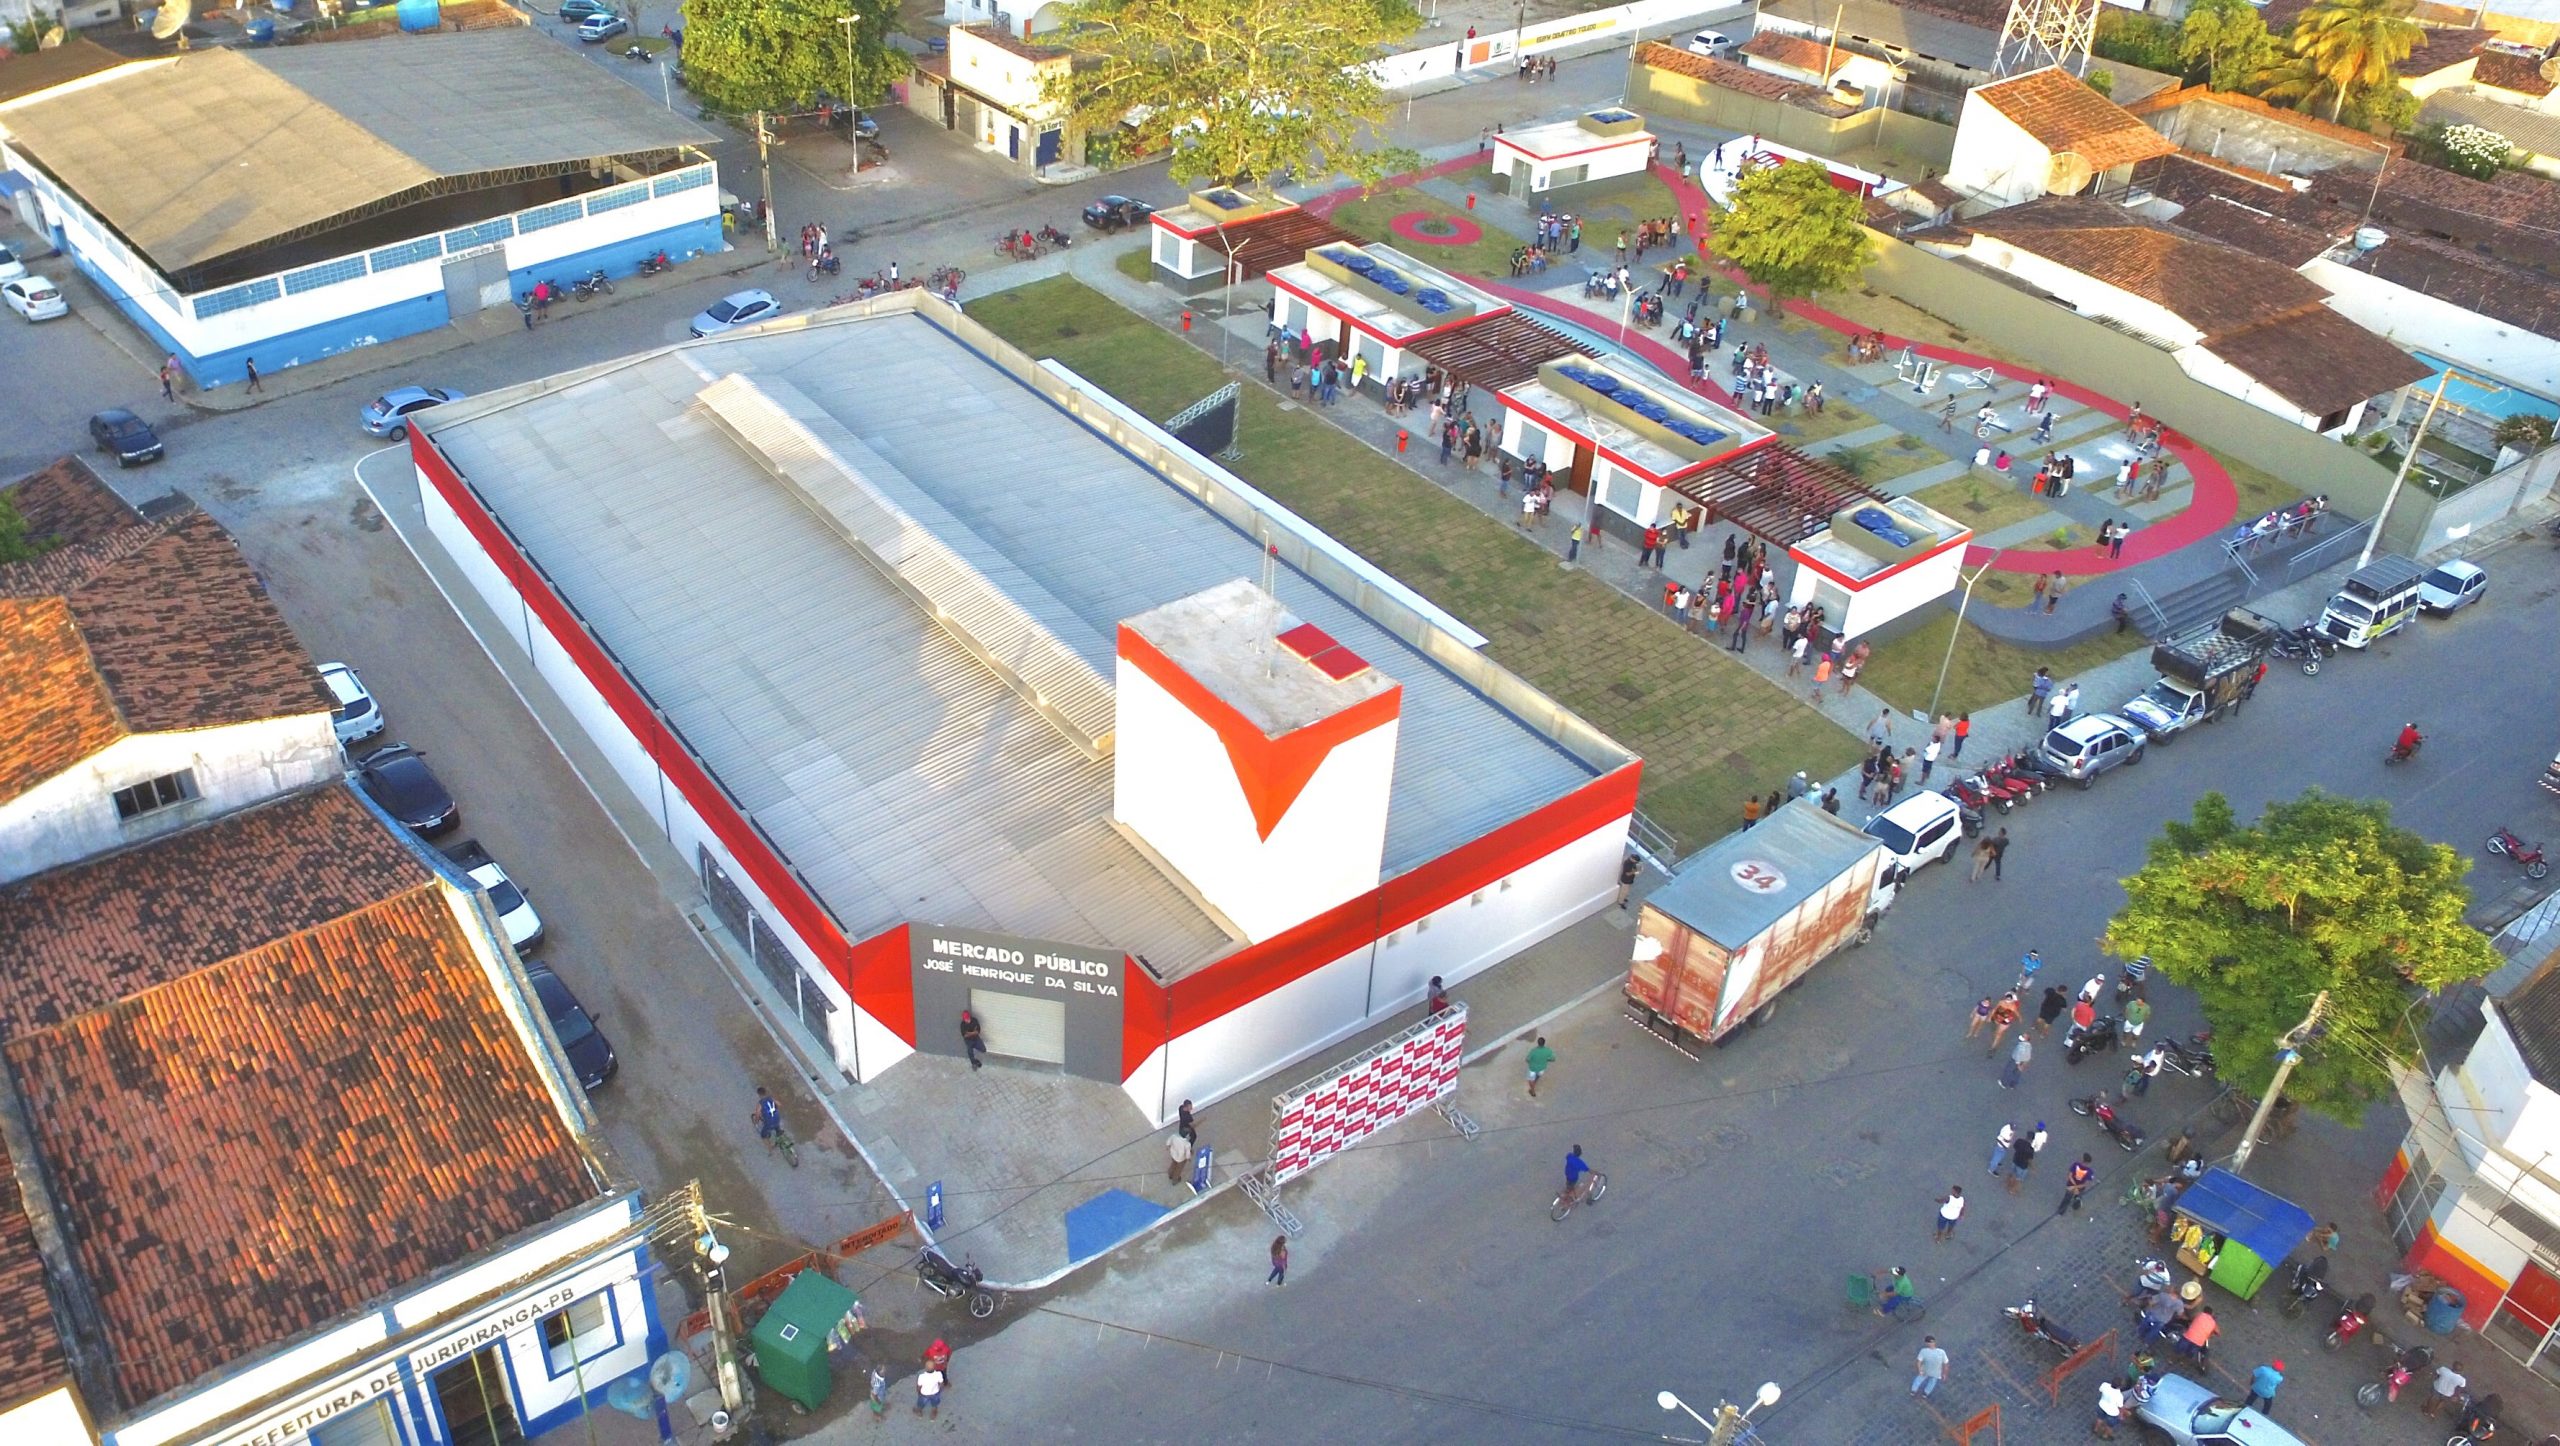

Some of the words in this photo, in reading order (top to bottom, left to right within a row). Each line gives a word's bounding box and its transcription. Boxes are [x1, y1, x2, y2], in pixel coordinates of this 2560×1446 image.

[1736, 864, 1777, 889] 34
[932, 938, 1024, 966] MERCADO
[1034, 952, 1109, 977] PÚBLICO
[922, 958, 954, 973] JOSÉ
[962, 964, 1035, 984] HENRIQUE
[1045, 976, 1066, 989] DA
[1073, 980, 1118, 996] SILVA
[241, 1390, 365, 1446] EFEITURA
[370, 1370, 400, 1394] DE
[415, 1287, 574, 1373] JURIPIRANGA-PB
